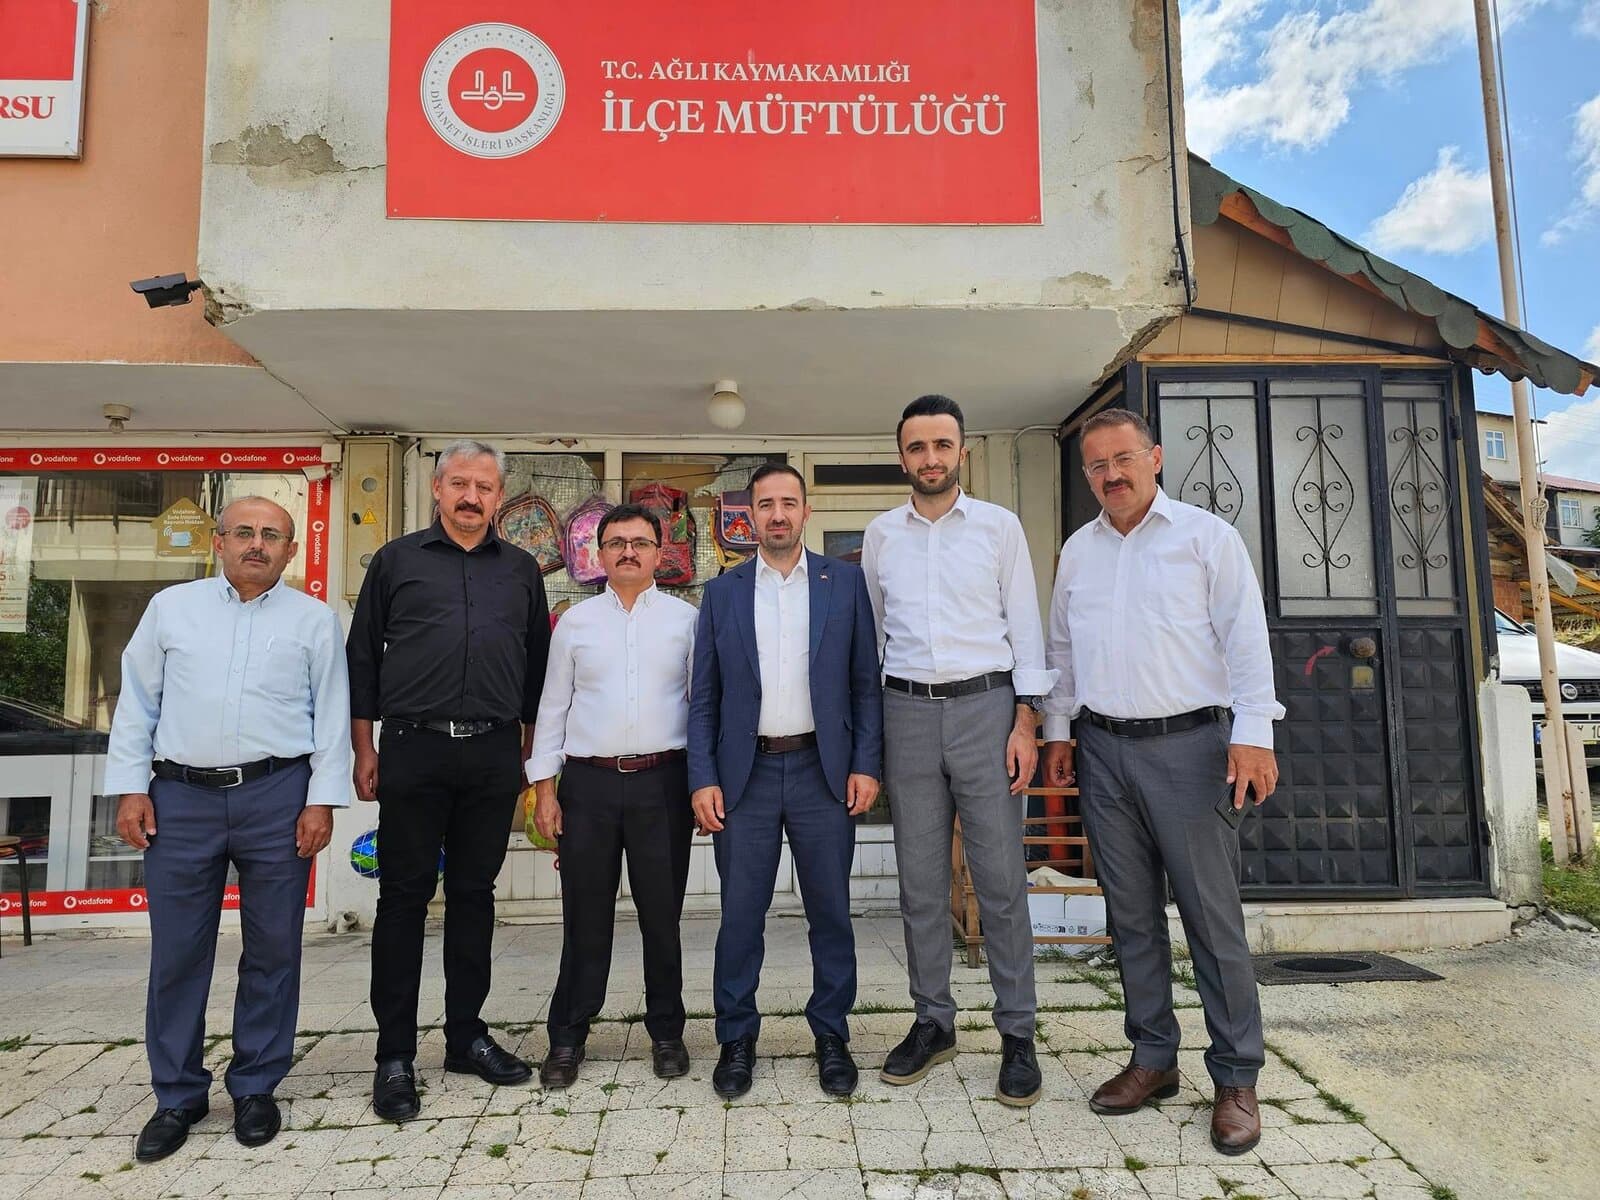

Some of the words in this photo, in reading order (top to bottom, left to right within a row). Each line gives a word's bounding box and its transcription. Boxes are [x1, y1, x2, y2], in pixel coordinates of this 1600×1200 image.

[601, 60, 643, 79] T.C.
[649, 57, 709, 80] AĞLI
[713, 60, 910, 83] KAYMAKAMLIĞI
[602, 89, 705, 142] İLÇE
[714, 93, 1007, 135] MÜFTÜLÜĞÜ
[44, 455, 77, 463] vodafone
[107, 454, 141, 462] vodafone
[171, 454, 205, 462] vodafone
[233, 454, 267, 462] vodafone
[296, 454, 321, 462] vodafo
[78, 897, 113, 905] vodafone
